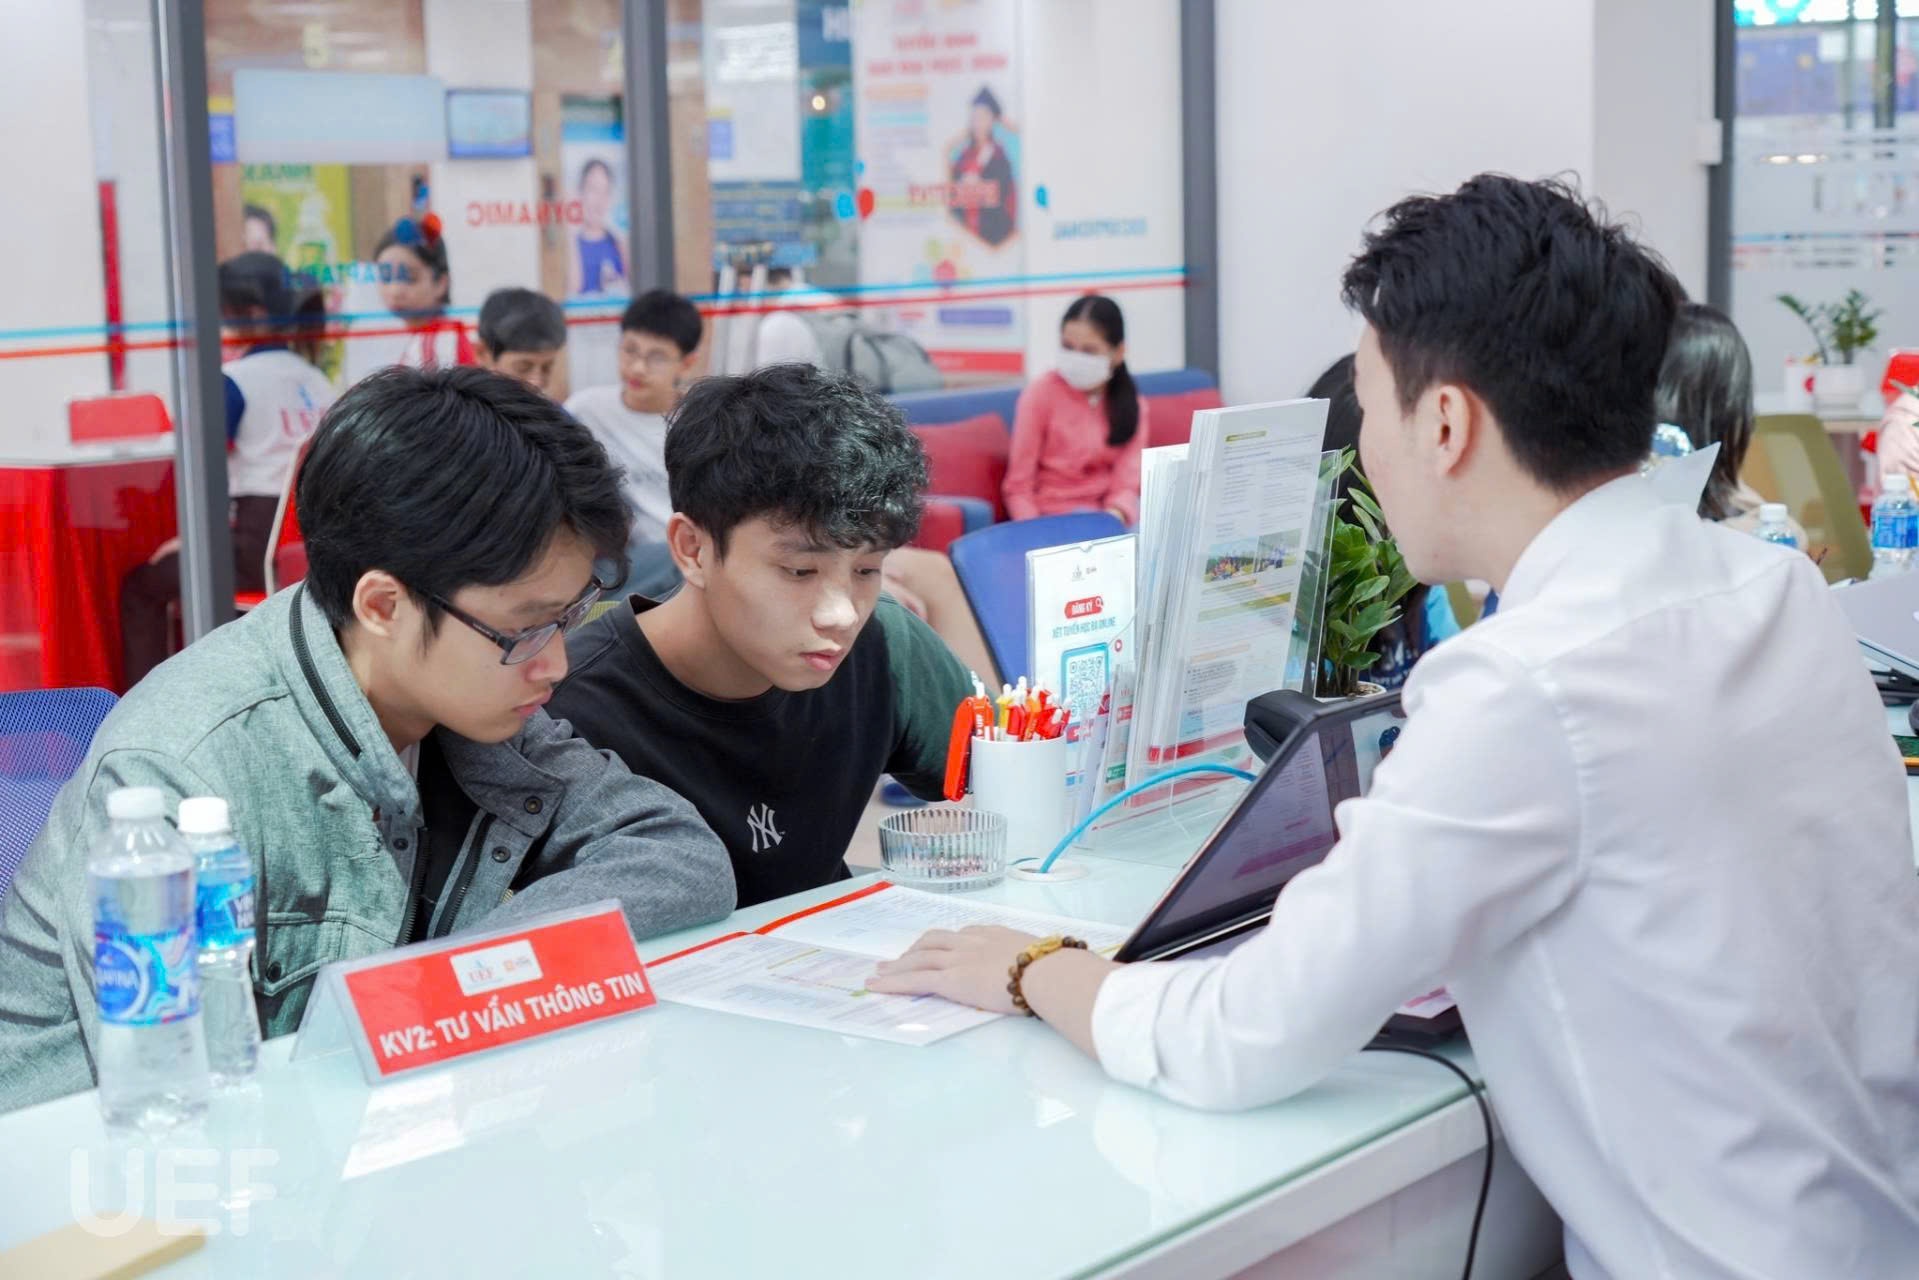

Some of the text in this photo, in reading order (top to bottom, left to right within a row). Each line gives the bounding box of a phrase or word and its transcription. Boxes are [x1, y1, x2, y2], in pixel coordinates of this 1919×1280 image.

[379, 1023, 437, 1059] KV2:
[435, 1009, 471, 1044] TƯ
[473, 993, 526, 1034] VẤN
[524, 982, 605, 1020] THÔNG
[604, 971, 646, 1000] TIN
